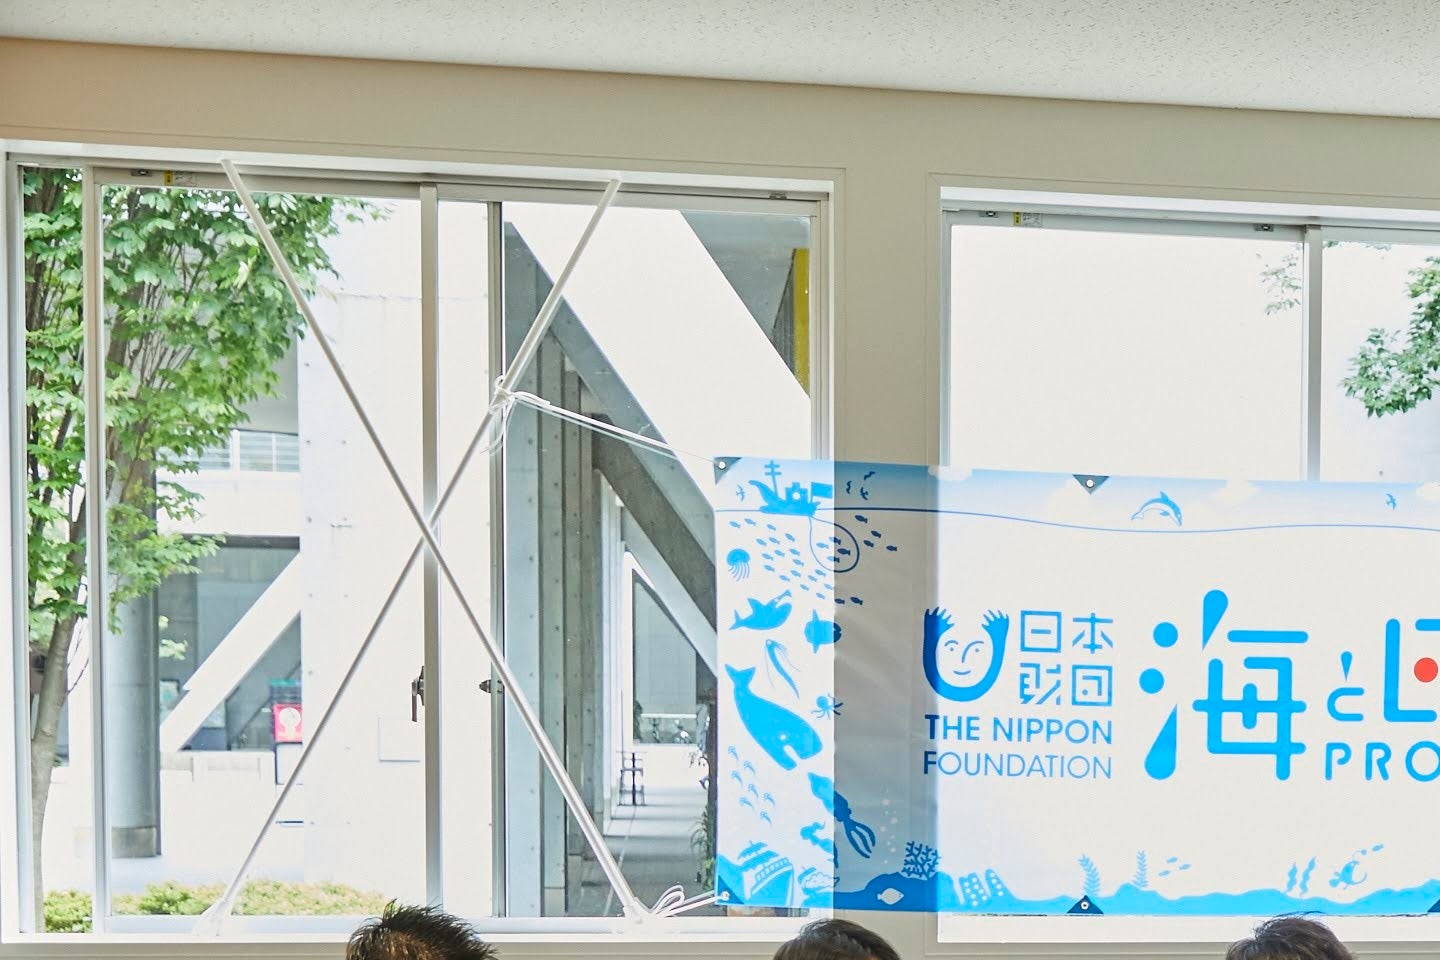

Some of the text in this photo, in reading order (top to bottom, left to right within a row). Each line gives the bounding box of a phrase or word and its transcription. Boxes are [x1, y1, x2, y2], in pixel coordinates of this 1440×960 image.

[1020, 610, 1113, 653] 日本
[925, 713, 1112, 744] THE NIPPON
[922, 750, 1111, 778] FOUNDATION
